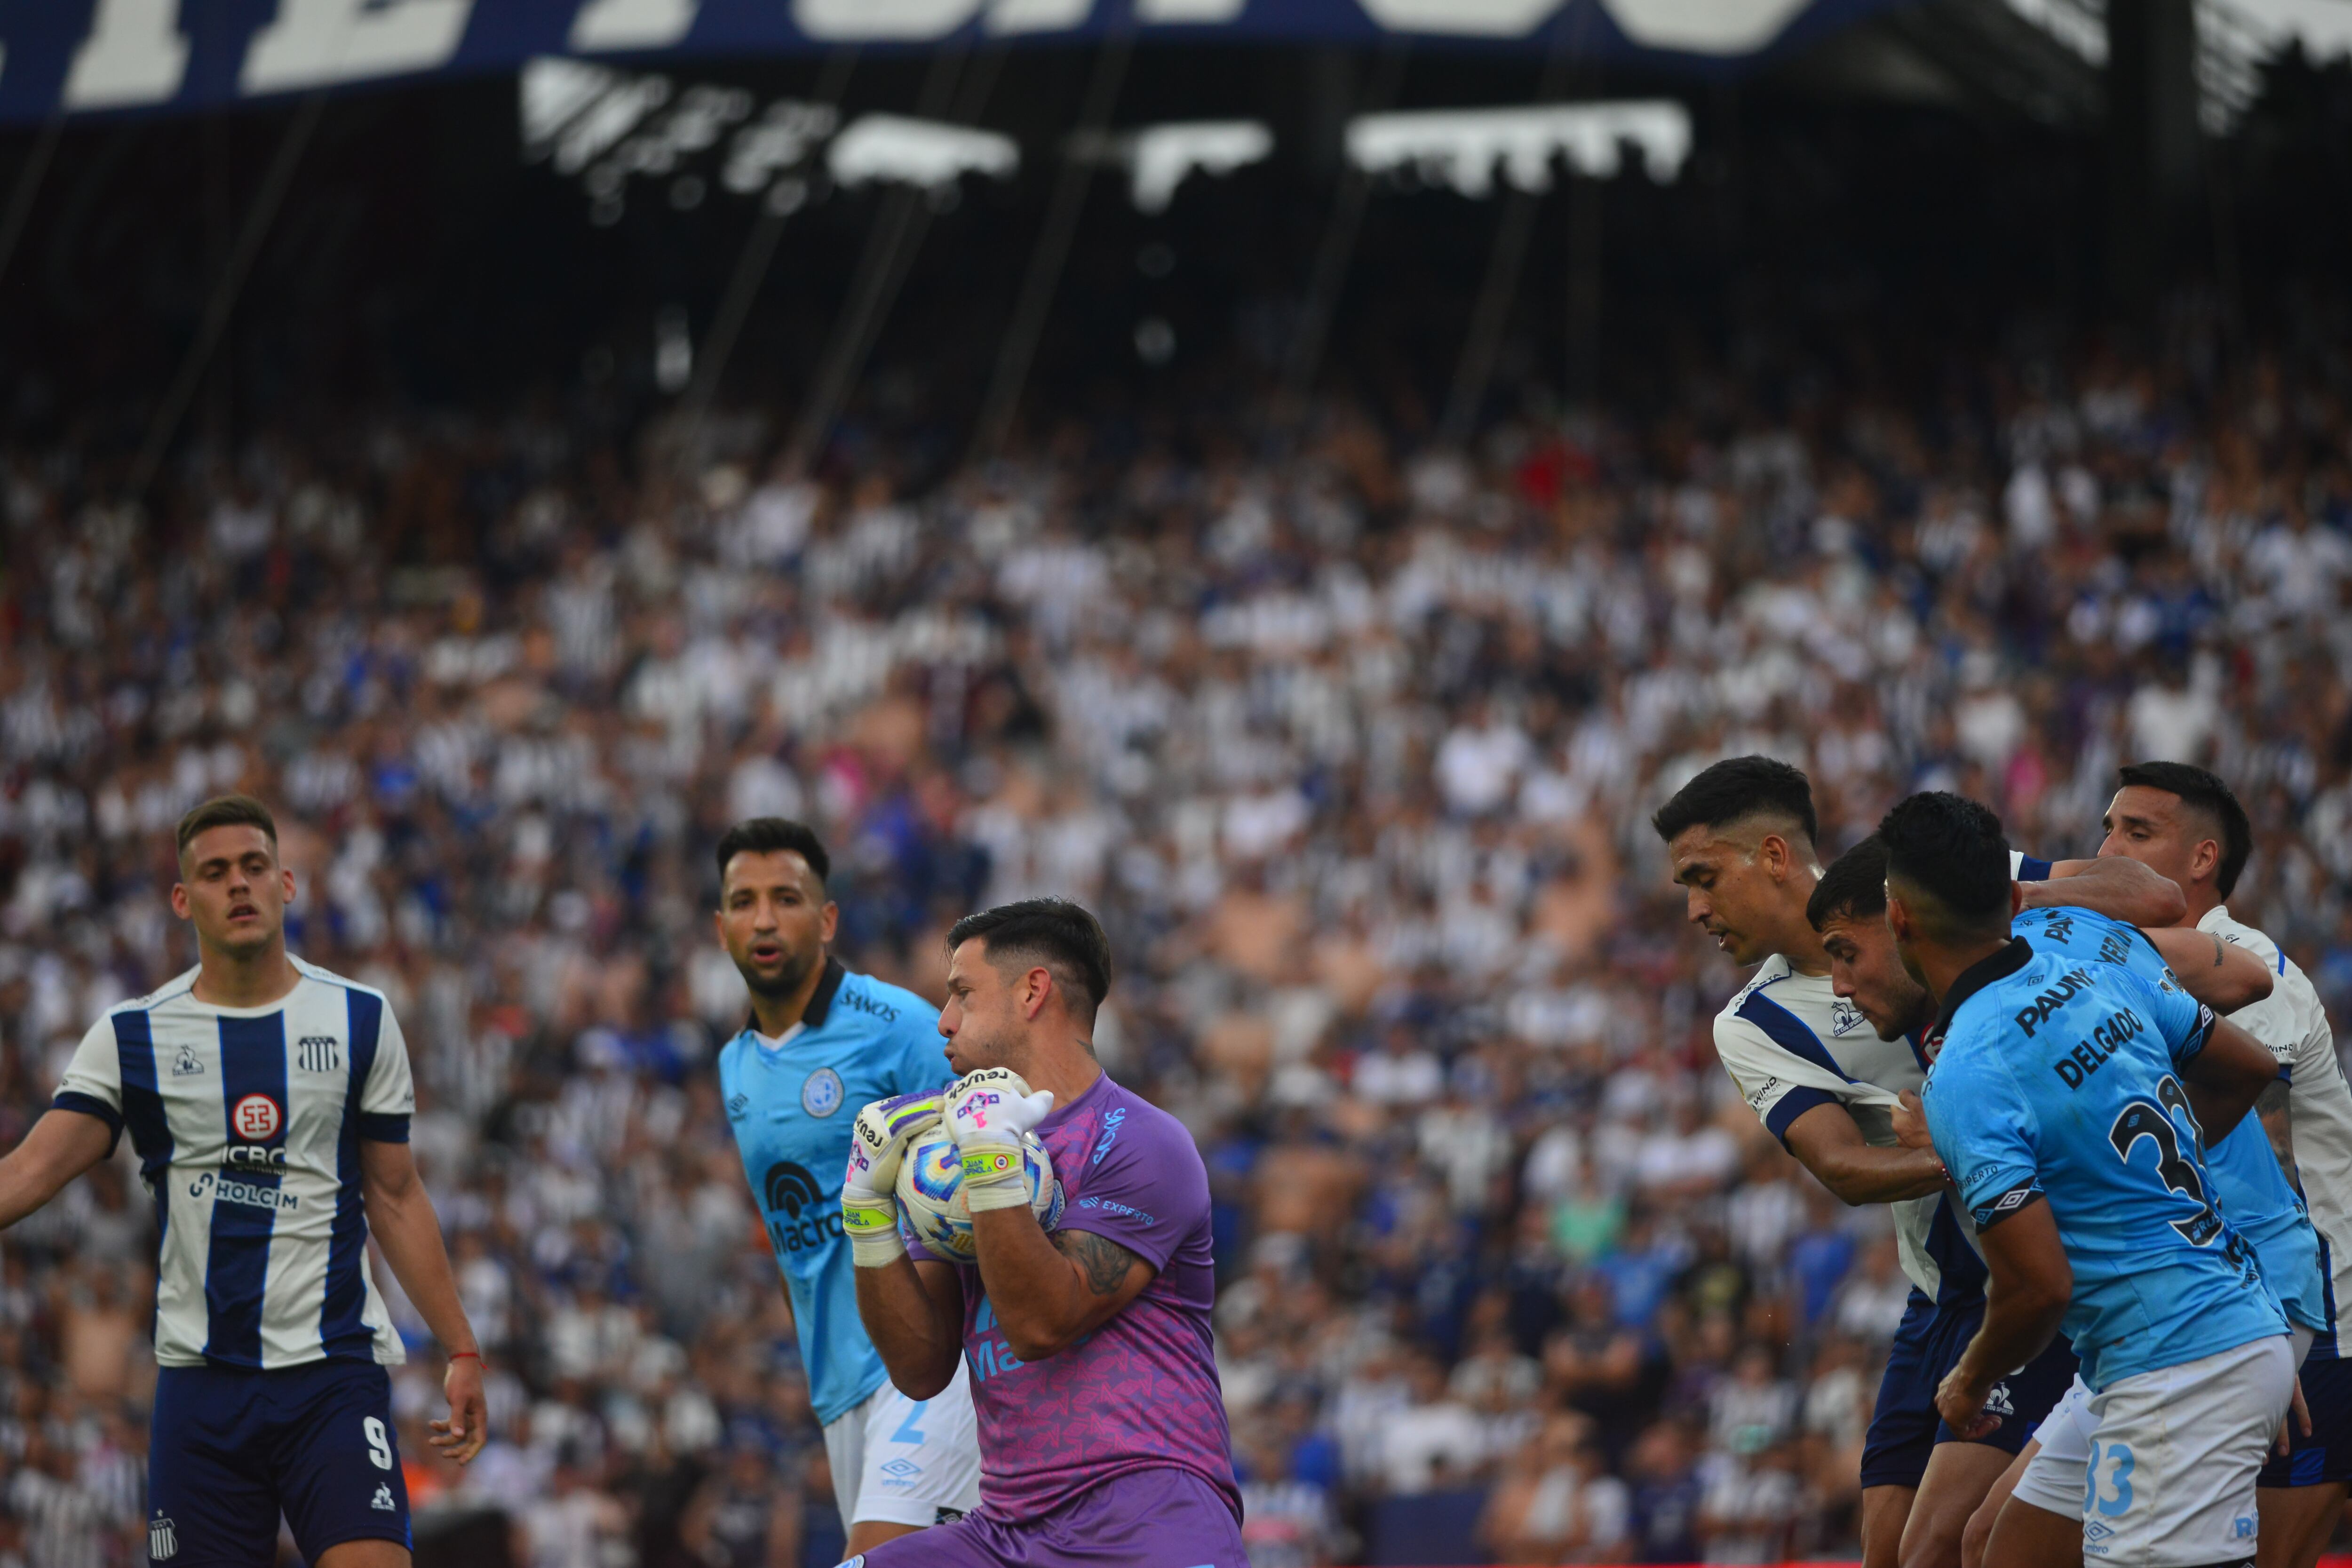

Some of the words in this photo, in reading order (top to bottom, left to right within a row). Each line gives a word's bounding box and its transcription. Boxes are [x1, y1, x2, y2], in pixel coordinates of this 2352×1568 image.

[840, 989, 900, 1022] SANOS
[2014, 967, 2096, 1039] PAUNY
[2053, 1007, 2144, 1091] DELGADO
[949, 1071, 1009, 1099] reusch
[1093, 1107, 1126, 1164] SANOS
[966, 1159, 983, 1168] JUAN
[215, 1181, 298, 1210] HOLCIM
[845, 1209, 860, 1218] JUAN
[1102, 1200, 1154, 1226] EXPERTO
[363, 1416, 393, 1471] 9
